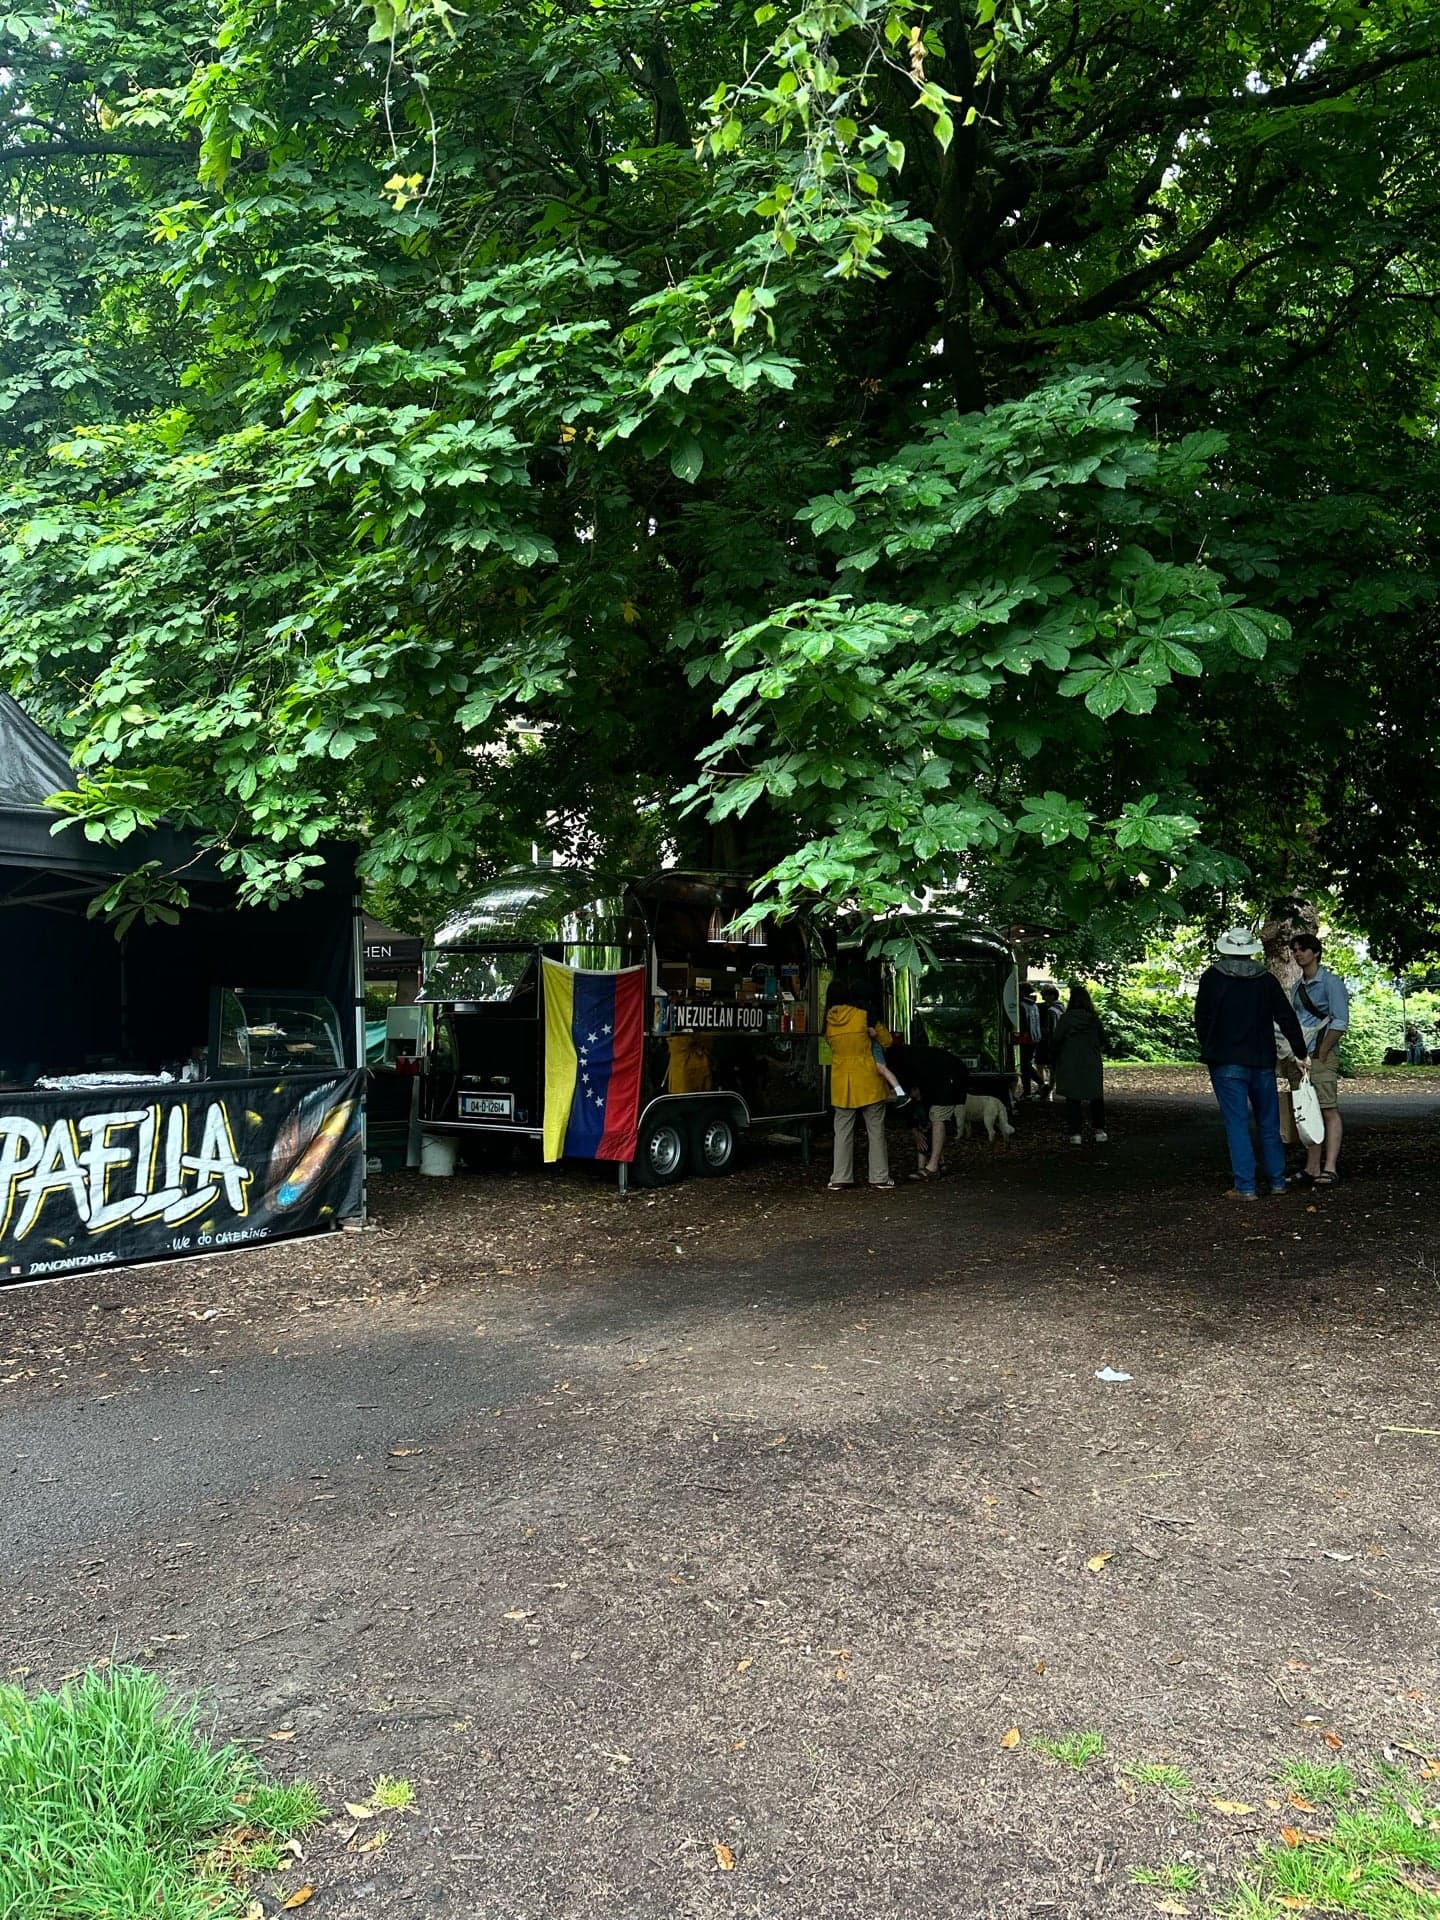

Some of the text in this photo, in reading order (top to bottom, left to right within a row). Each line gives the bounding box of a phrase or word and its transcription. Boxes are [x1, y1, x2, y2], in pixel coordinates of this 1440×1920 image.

[666, 1005, 763, 1028] NEZUELAN FOOD
[0, 1101, 252, 1240] PAELLA
[172, 1236, 190, 1250] We
[197, 1230, 212, 1245] do
